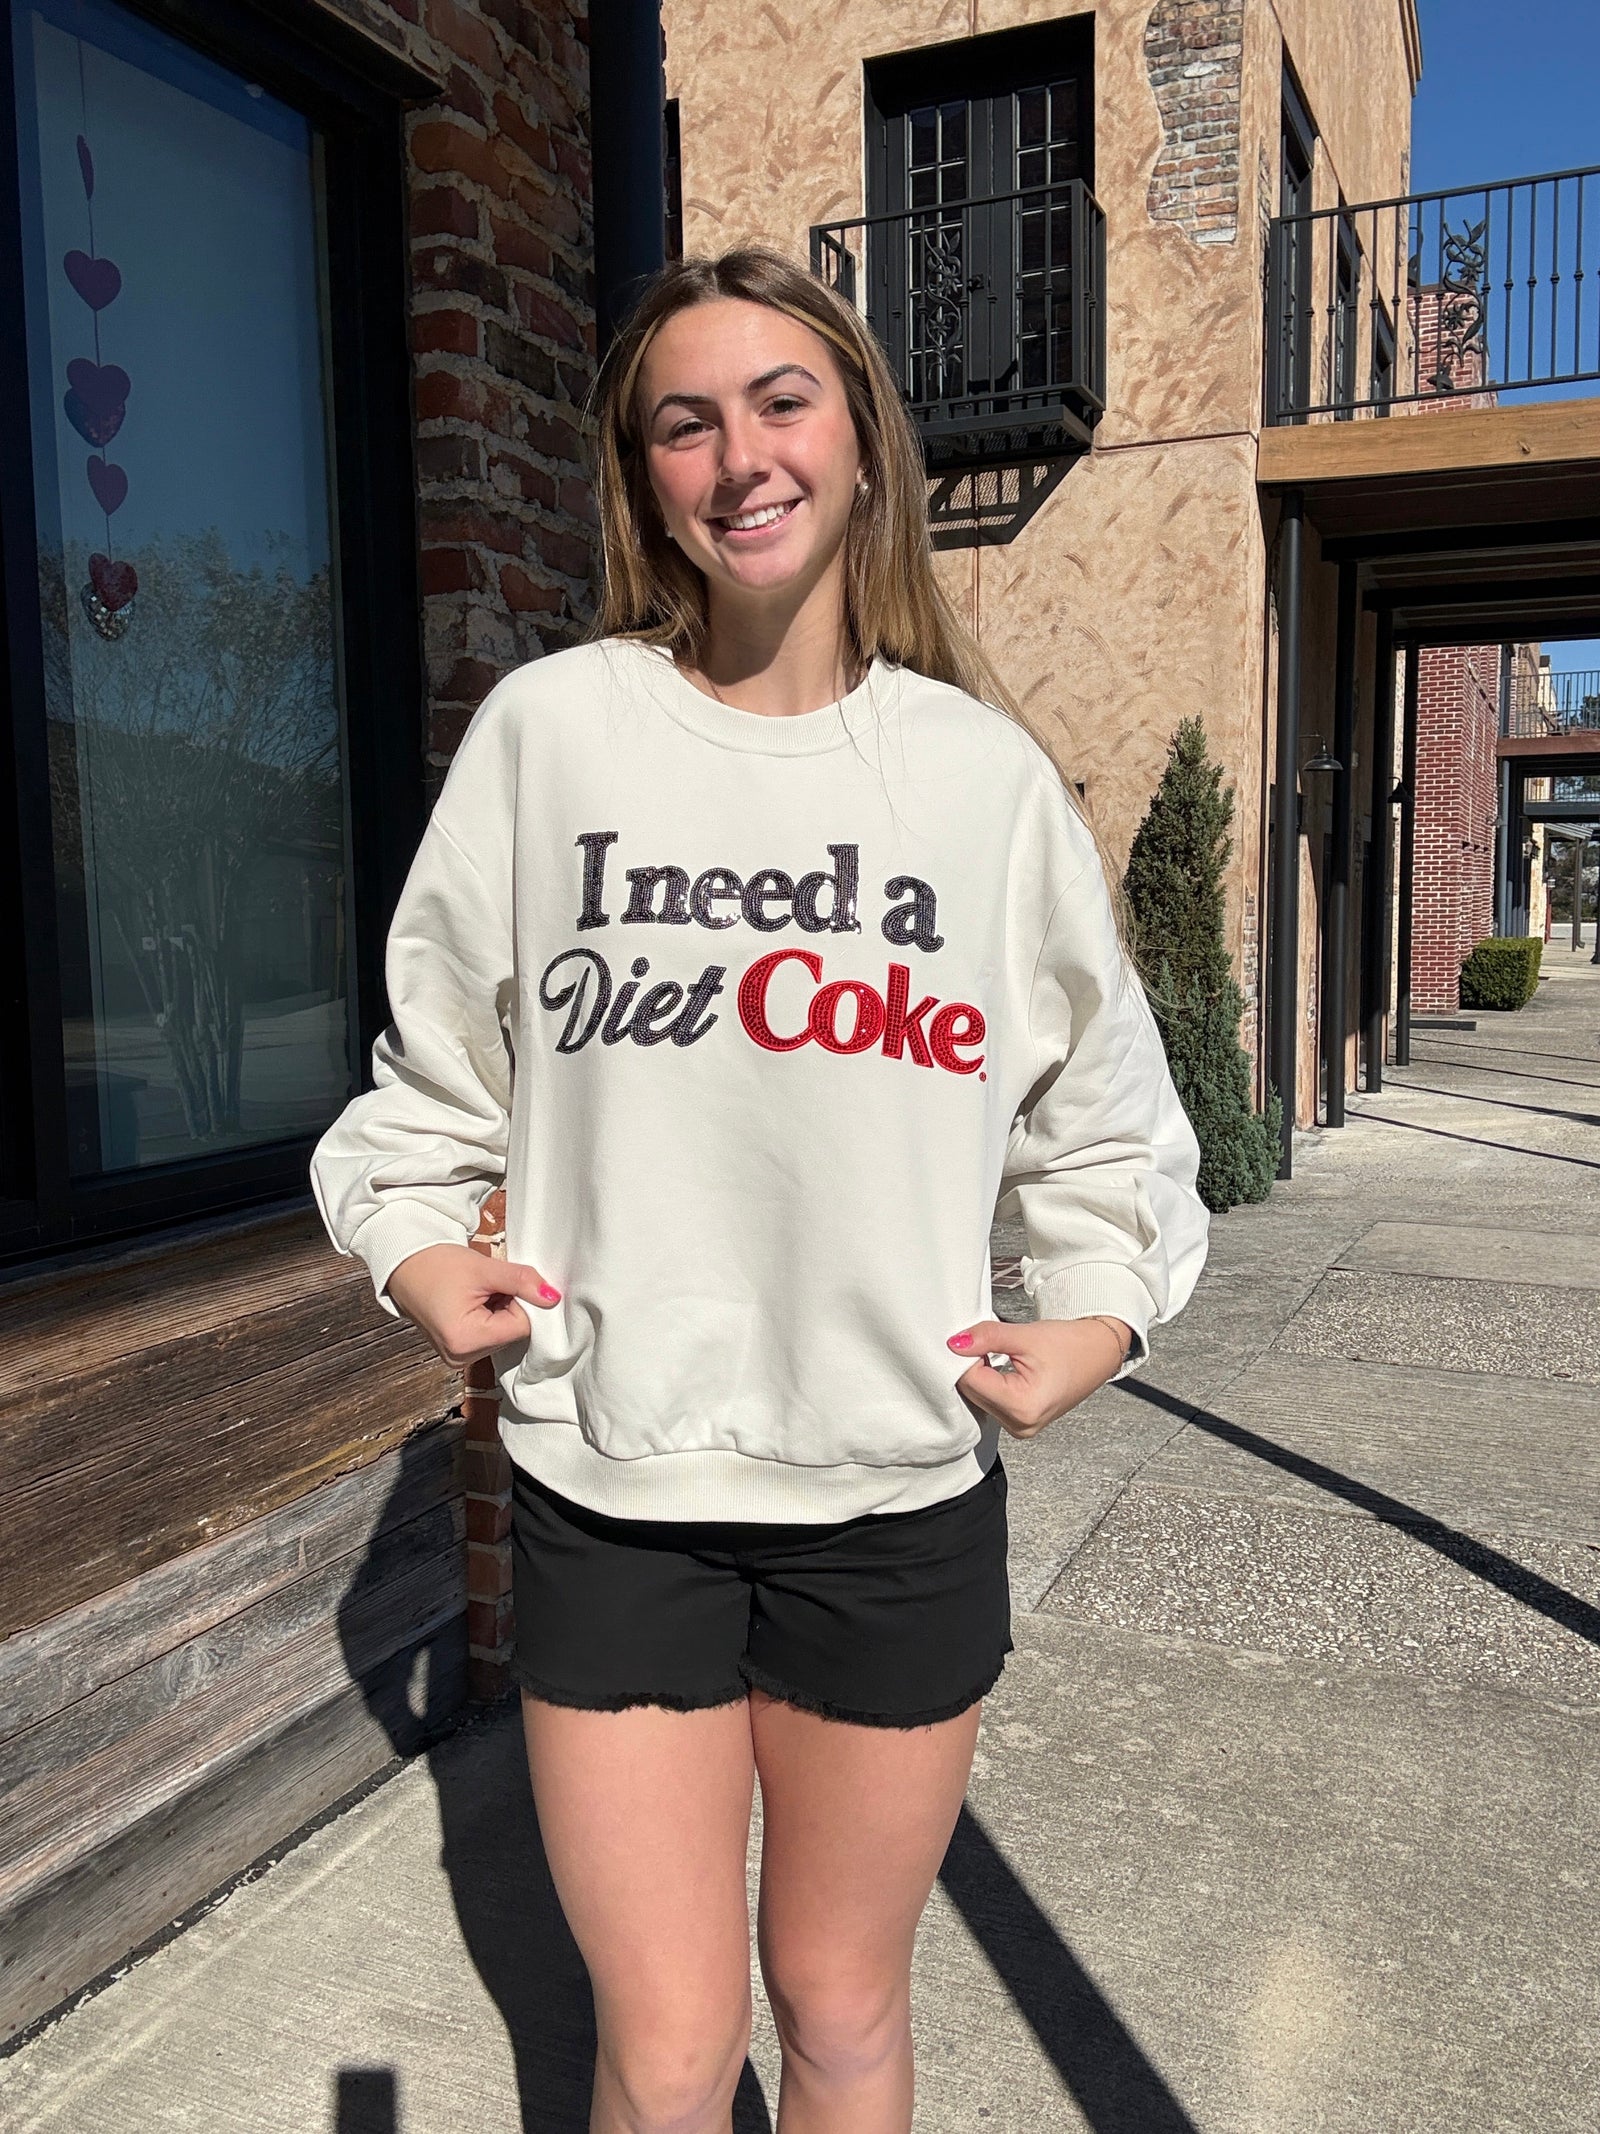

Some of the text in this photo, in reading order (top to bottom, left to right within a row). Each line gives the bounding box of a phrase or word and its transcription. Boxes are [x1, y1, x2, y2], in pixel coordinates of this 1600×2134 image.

[575, 831, 944, 953] I need a
[539, 948, 727, 1054] Diet
